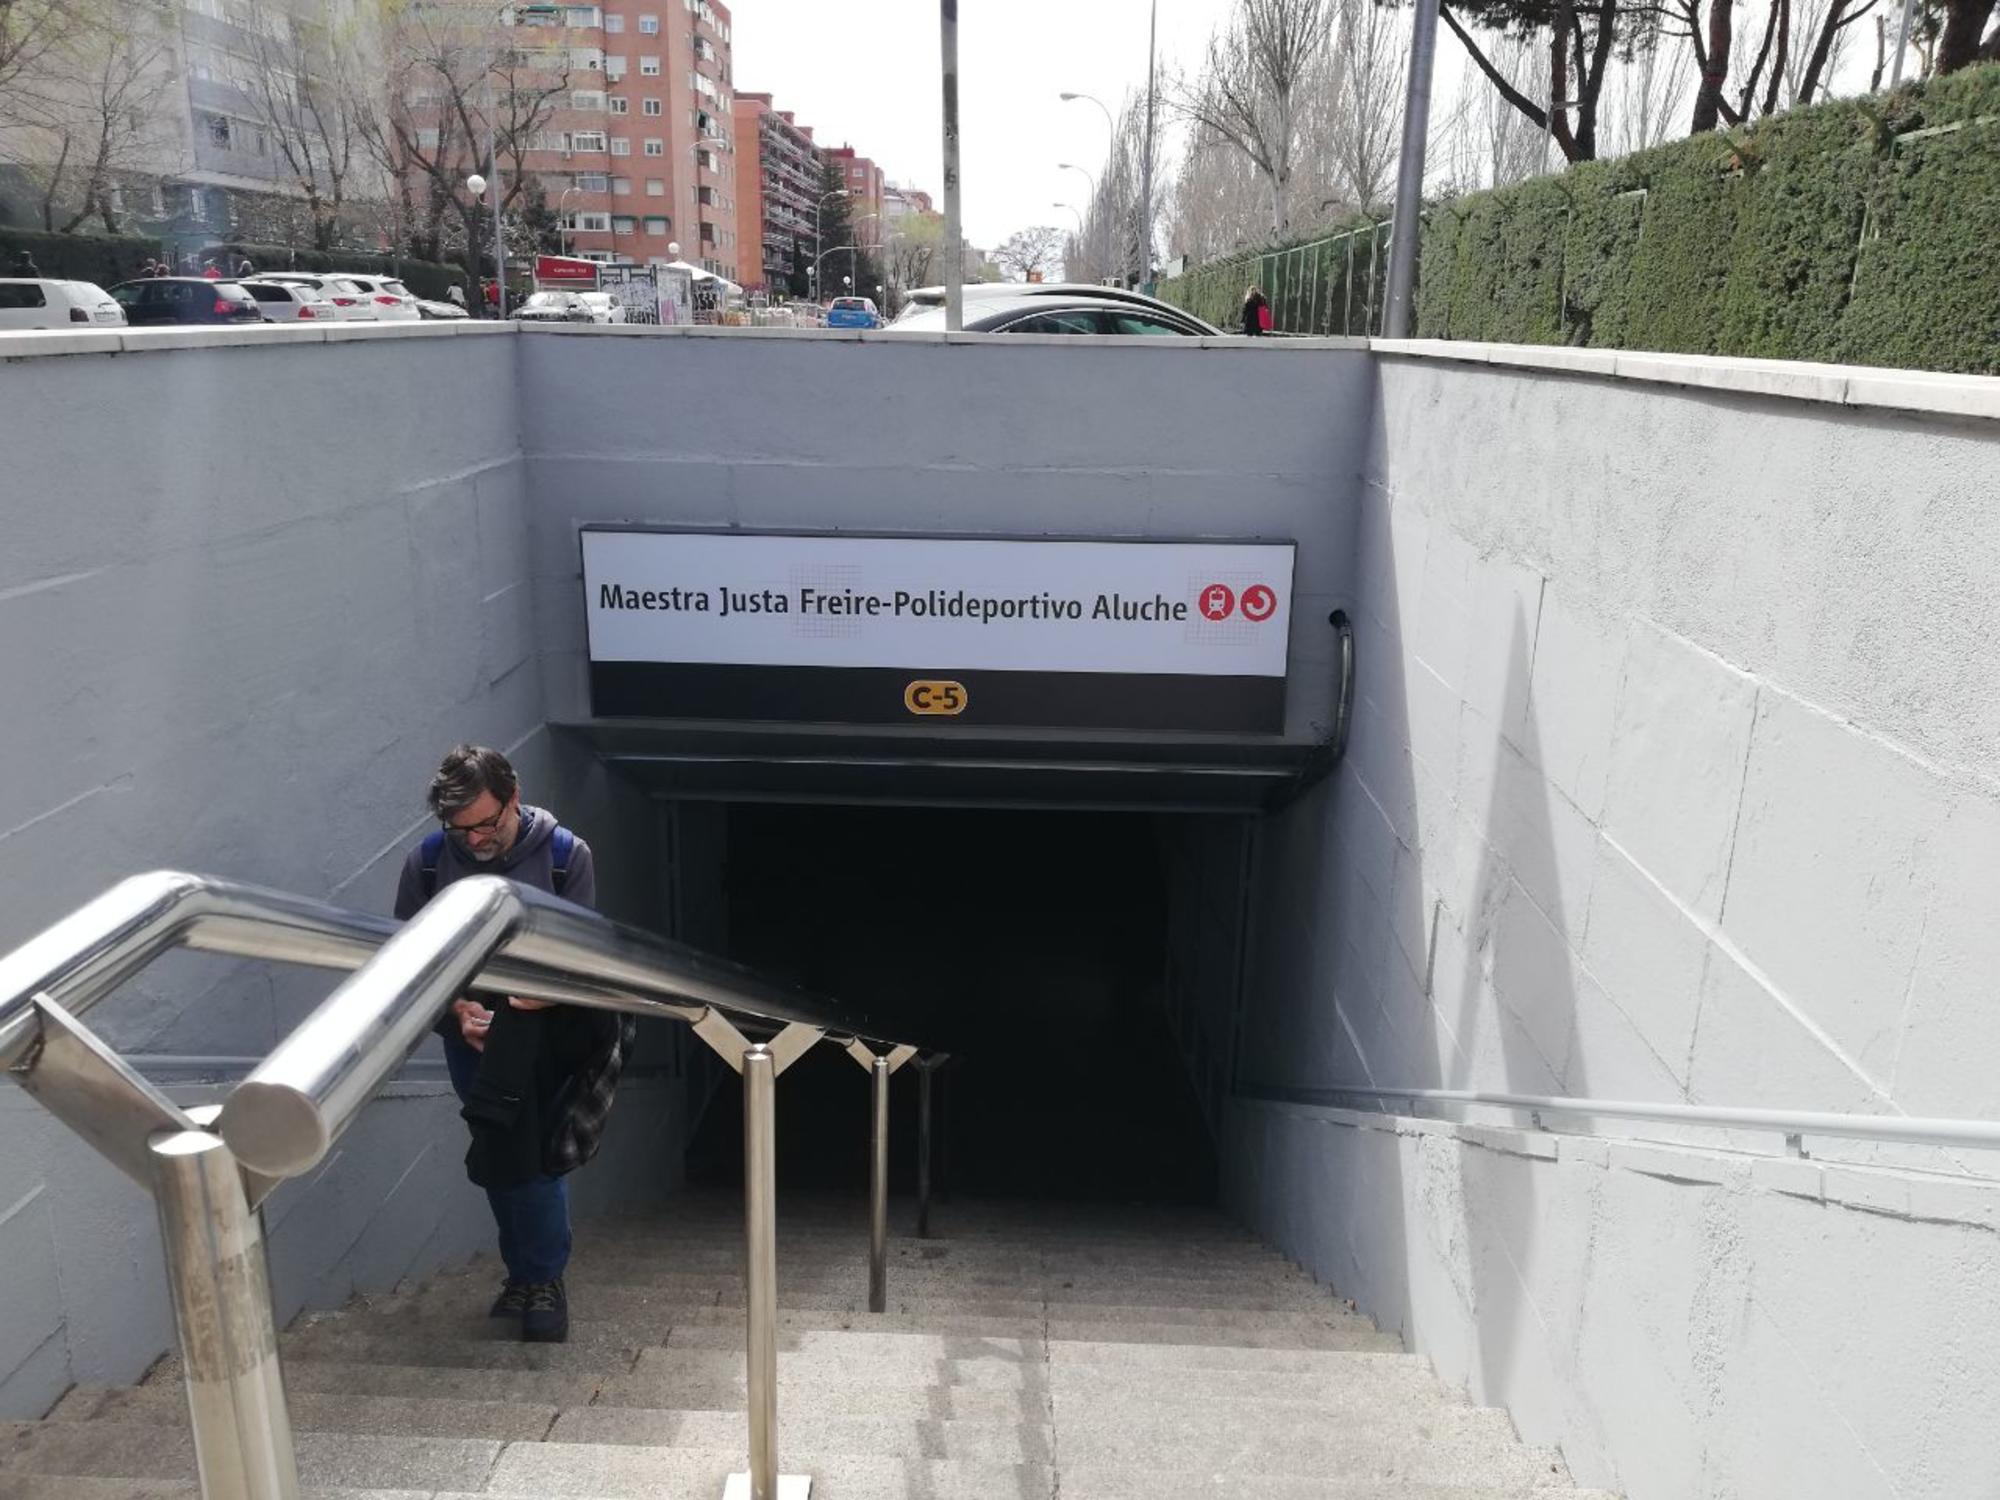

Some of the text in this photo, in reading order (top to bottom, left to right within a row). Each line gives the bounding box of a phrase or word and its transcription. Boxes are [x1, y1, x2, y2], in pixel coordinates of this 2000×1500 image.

[599, 583, 1188, 625] Maestra Justa Freire-Polideportivo Aluche
[912, 686, 959, 709] C-5
